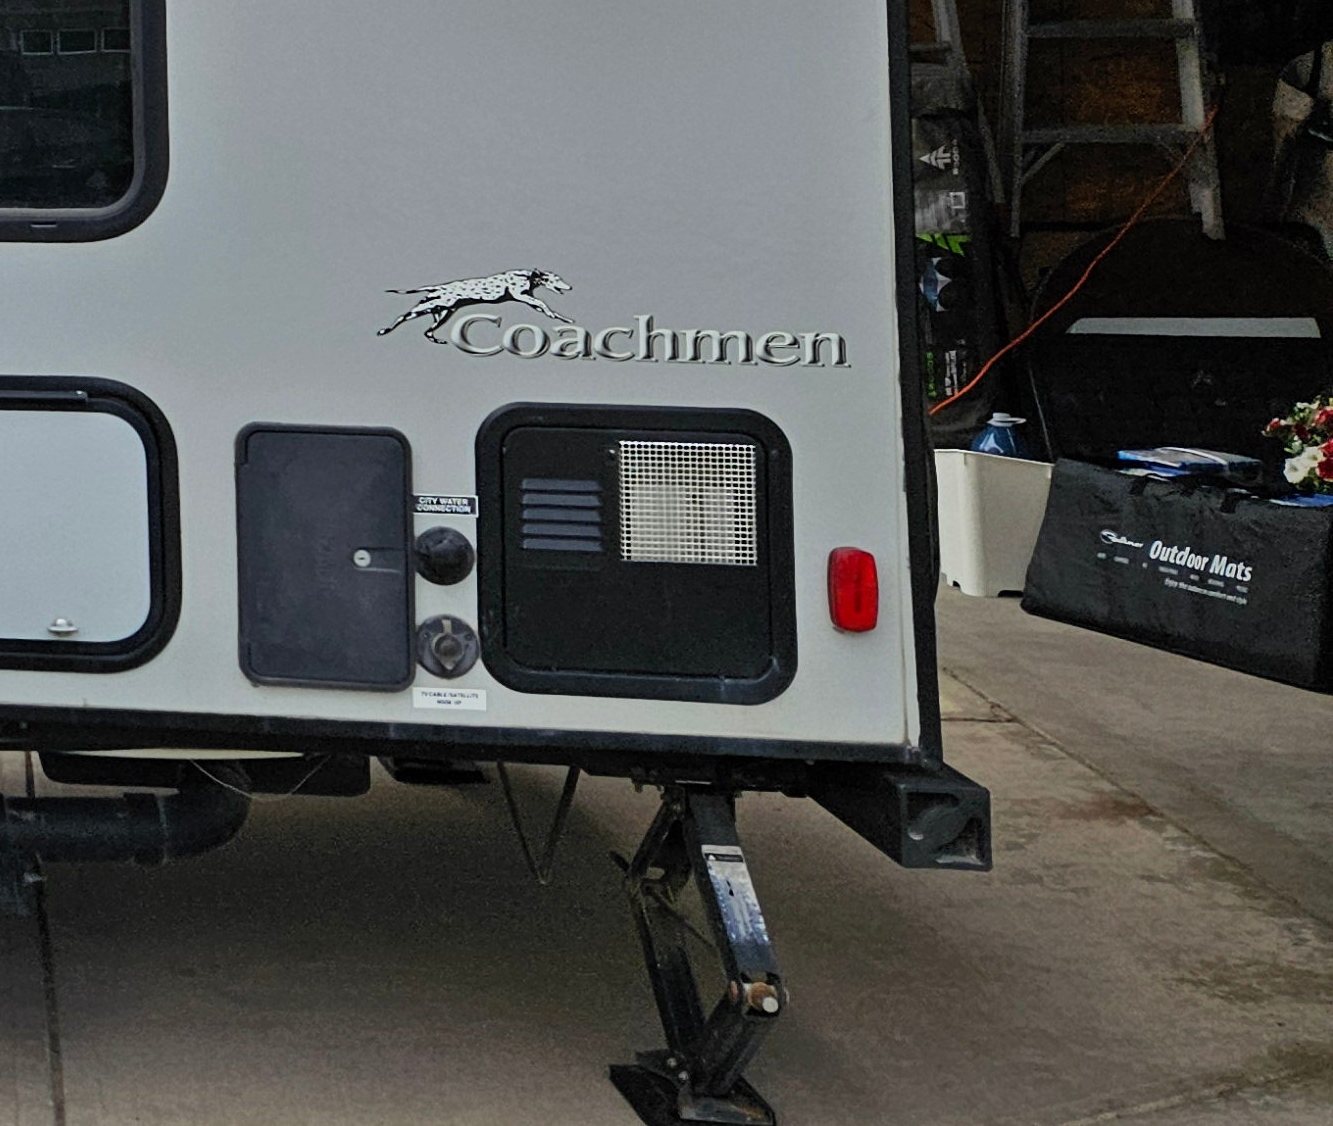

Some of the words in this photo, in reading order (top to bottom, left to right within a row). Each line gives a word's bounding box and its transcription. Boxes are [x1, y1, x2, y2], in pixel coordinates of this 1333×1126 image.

[450, 313, 852, 369] Coachmen
[415, 503, 472, 513] CONNECTION
[418, 496, 438, 505] CITY
[438, 497, 469, 506] WATER
[1149, 540, 1209, 571] Outdoor
[1209, 554, 1253, 582] Mats
